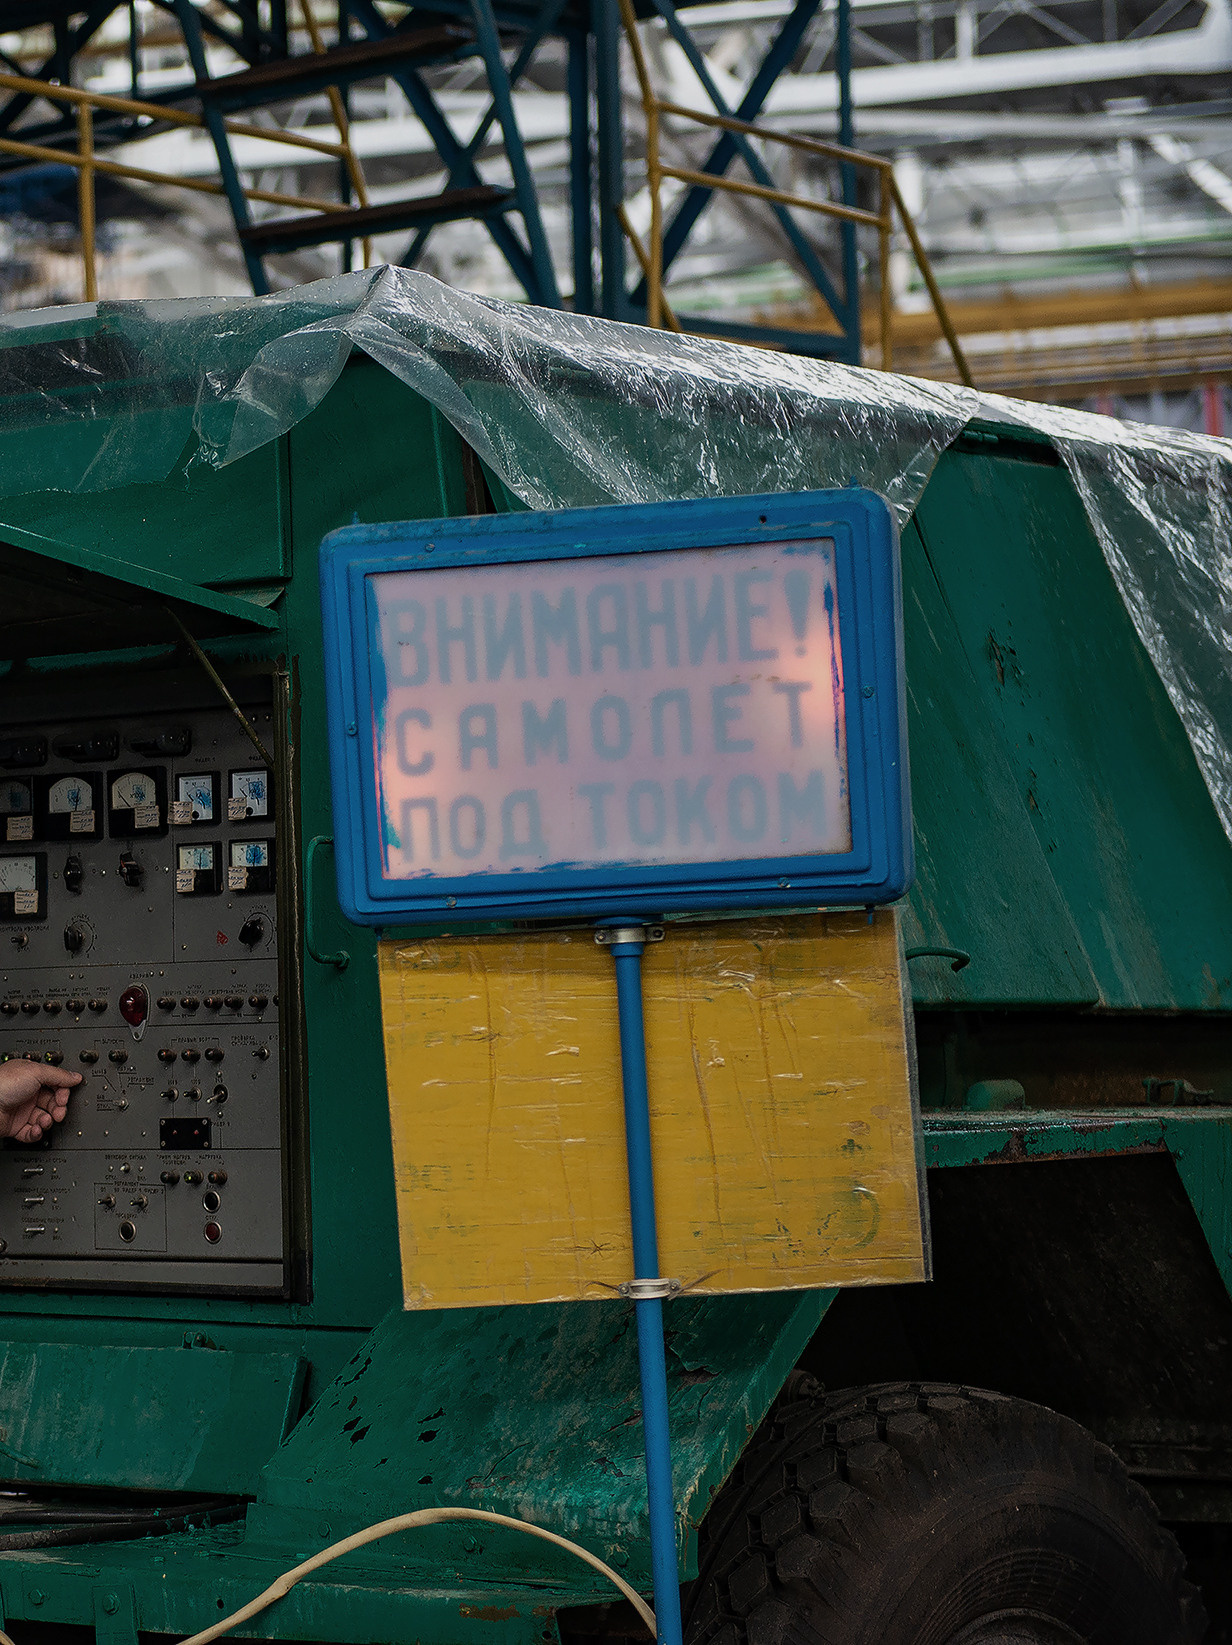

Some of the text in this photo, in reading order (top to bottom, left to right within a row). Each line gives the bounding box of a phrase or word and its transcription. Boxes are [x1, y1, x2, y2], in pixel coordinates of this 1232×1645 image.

[388, 568, 813, 687] ВНИМАНИЕ!
[394, 681, 813, 776] САМОЛЕТ
[400, 769, 828, 863] ПОД ТОКОМ
